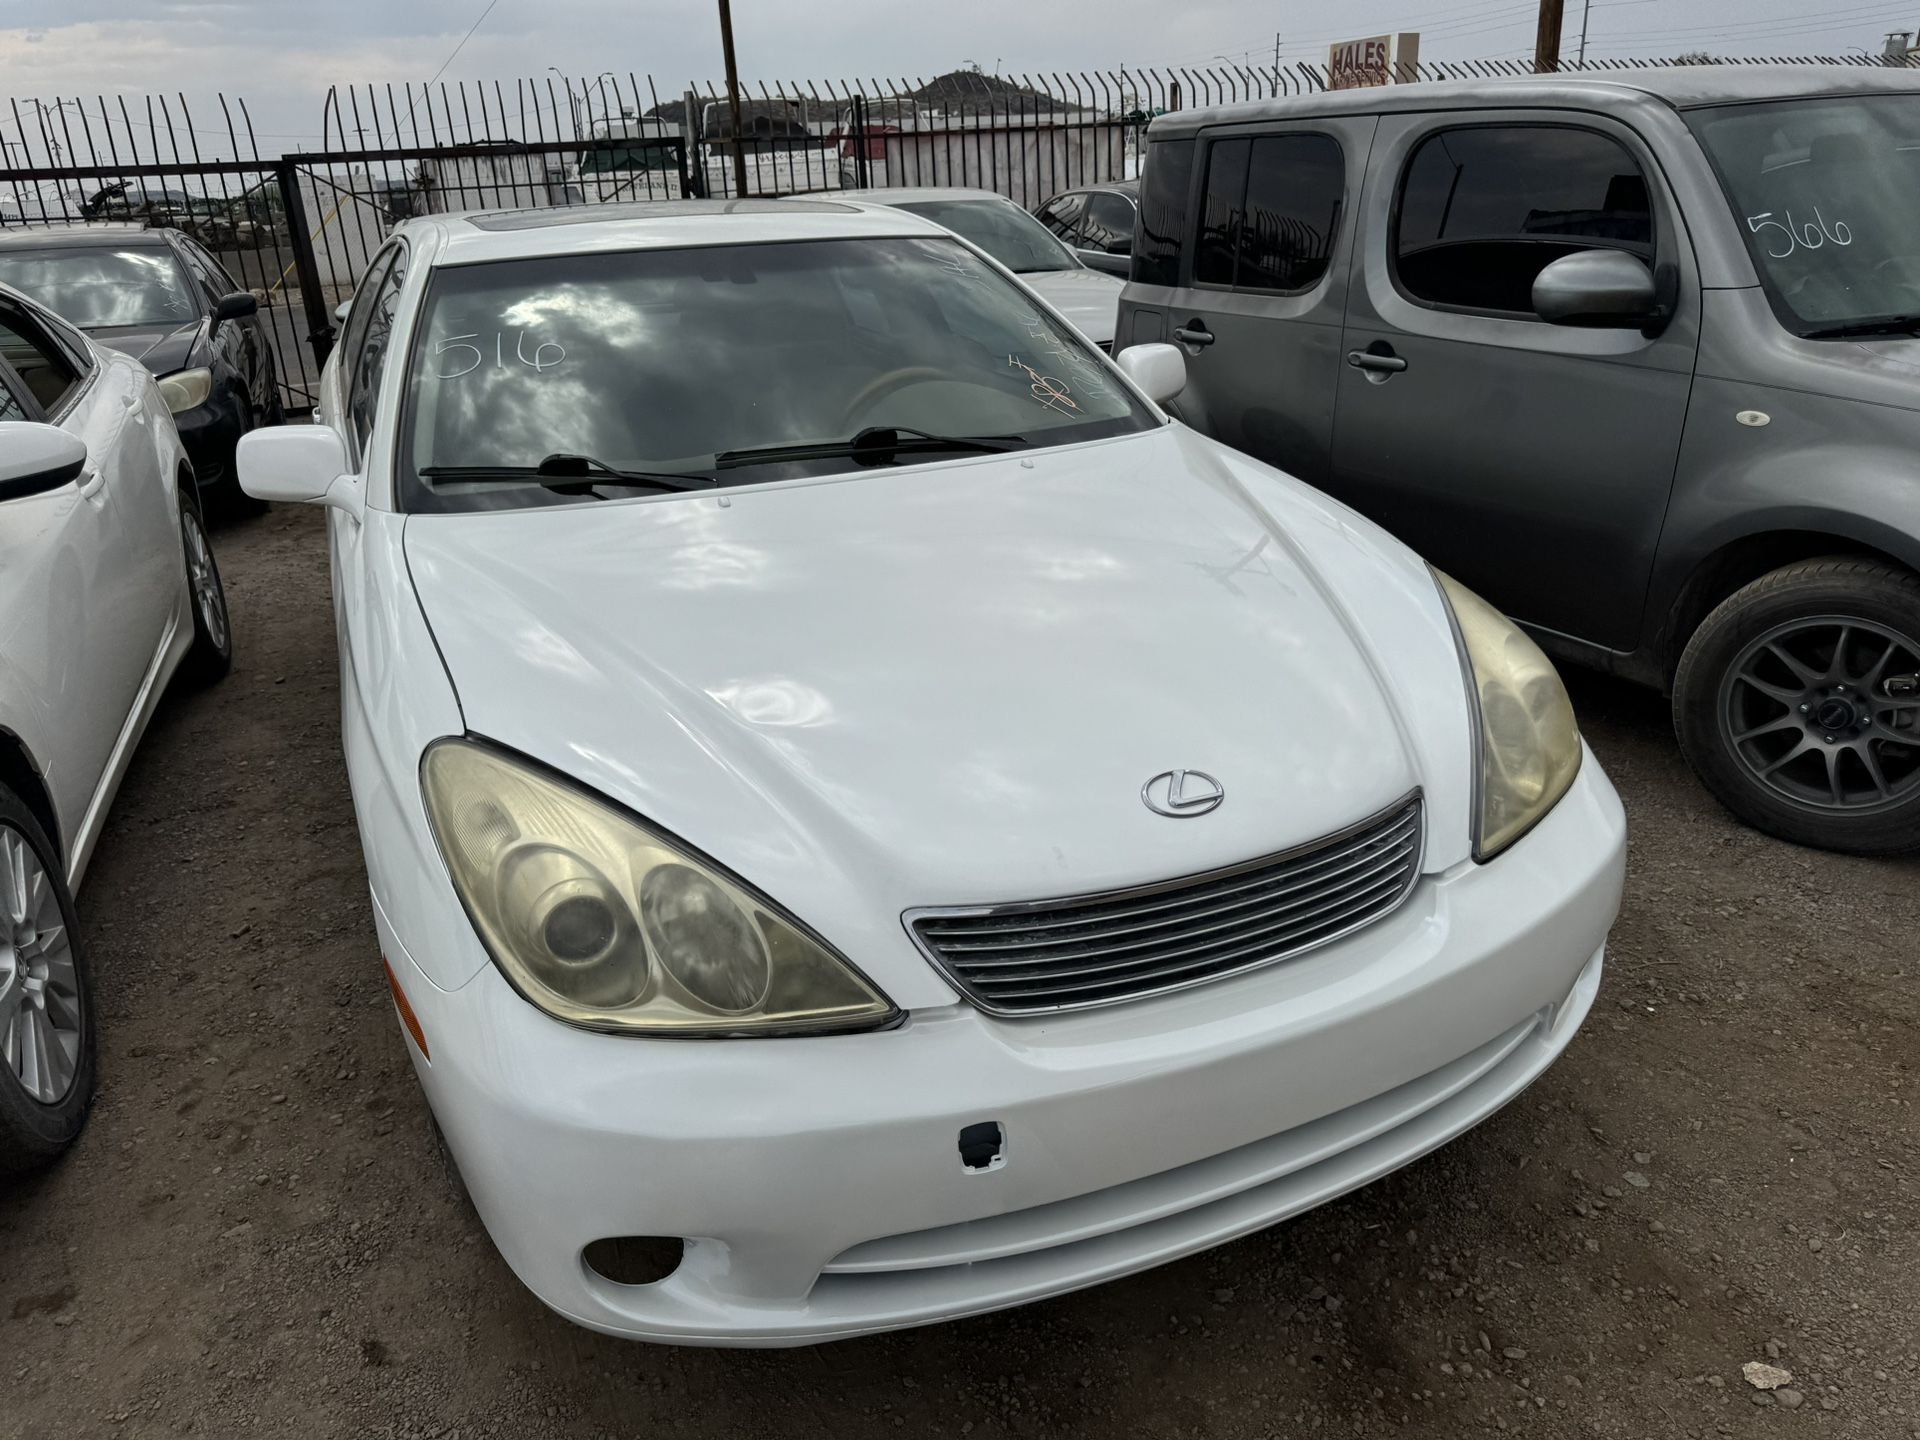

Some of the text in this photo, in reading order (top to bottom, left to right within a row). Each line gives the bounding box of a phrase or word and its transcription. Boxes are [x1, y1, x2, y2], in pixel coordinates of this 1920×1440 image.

[1332, 42, 1386, 77] HALES
[1748, 206, 1852, 258] 566
[436, 330, 566, 379] 516
